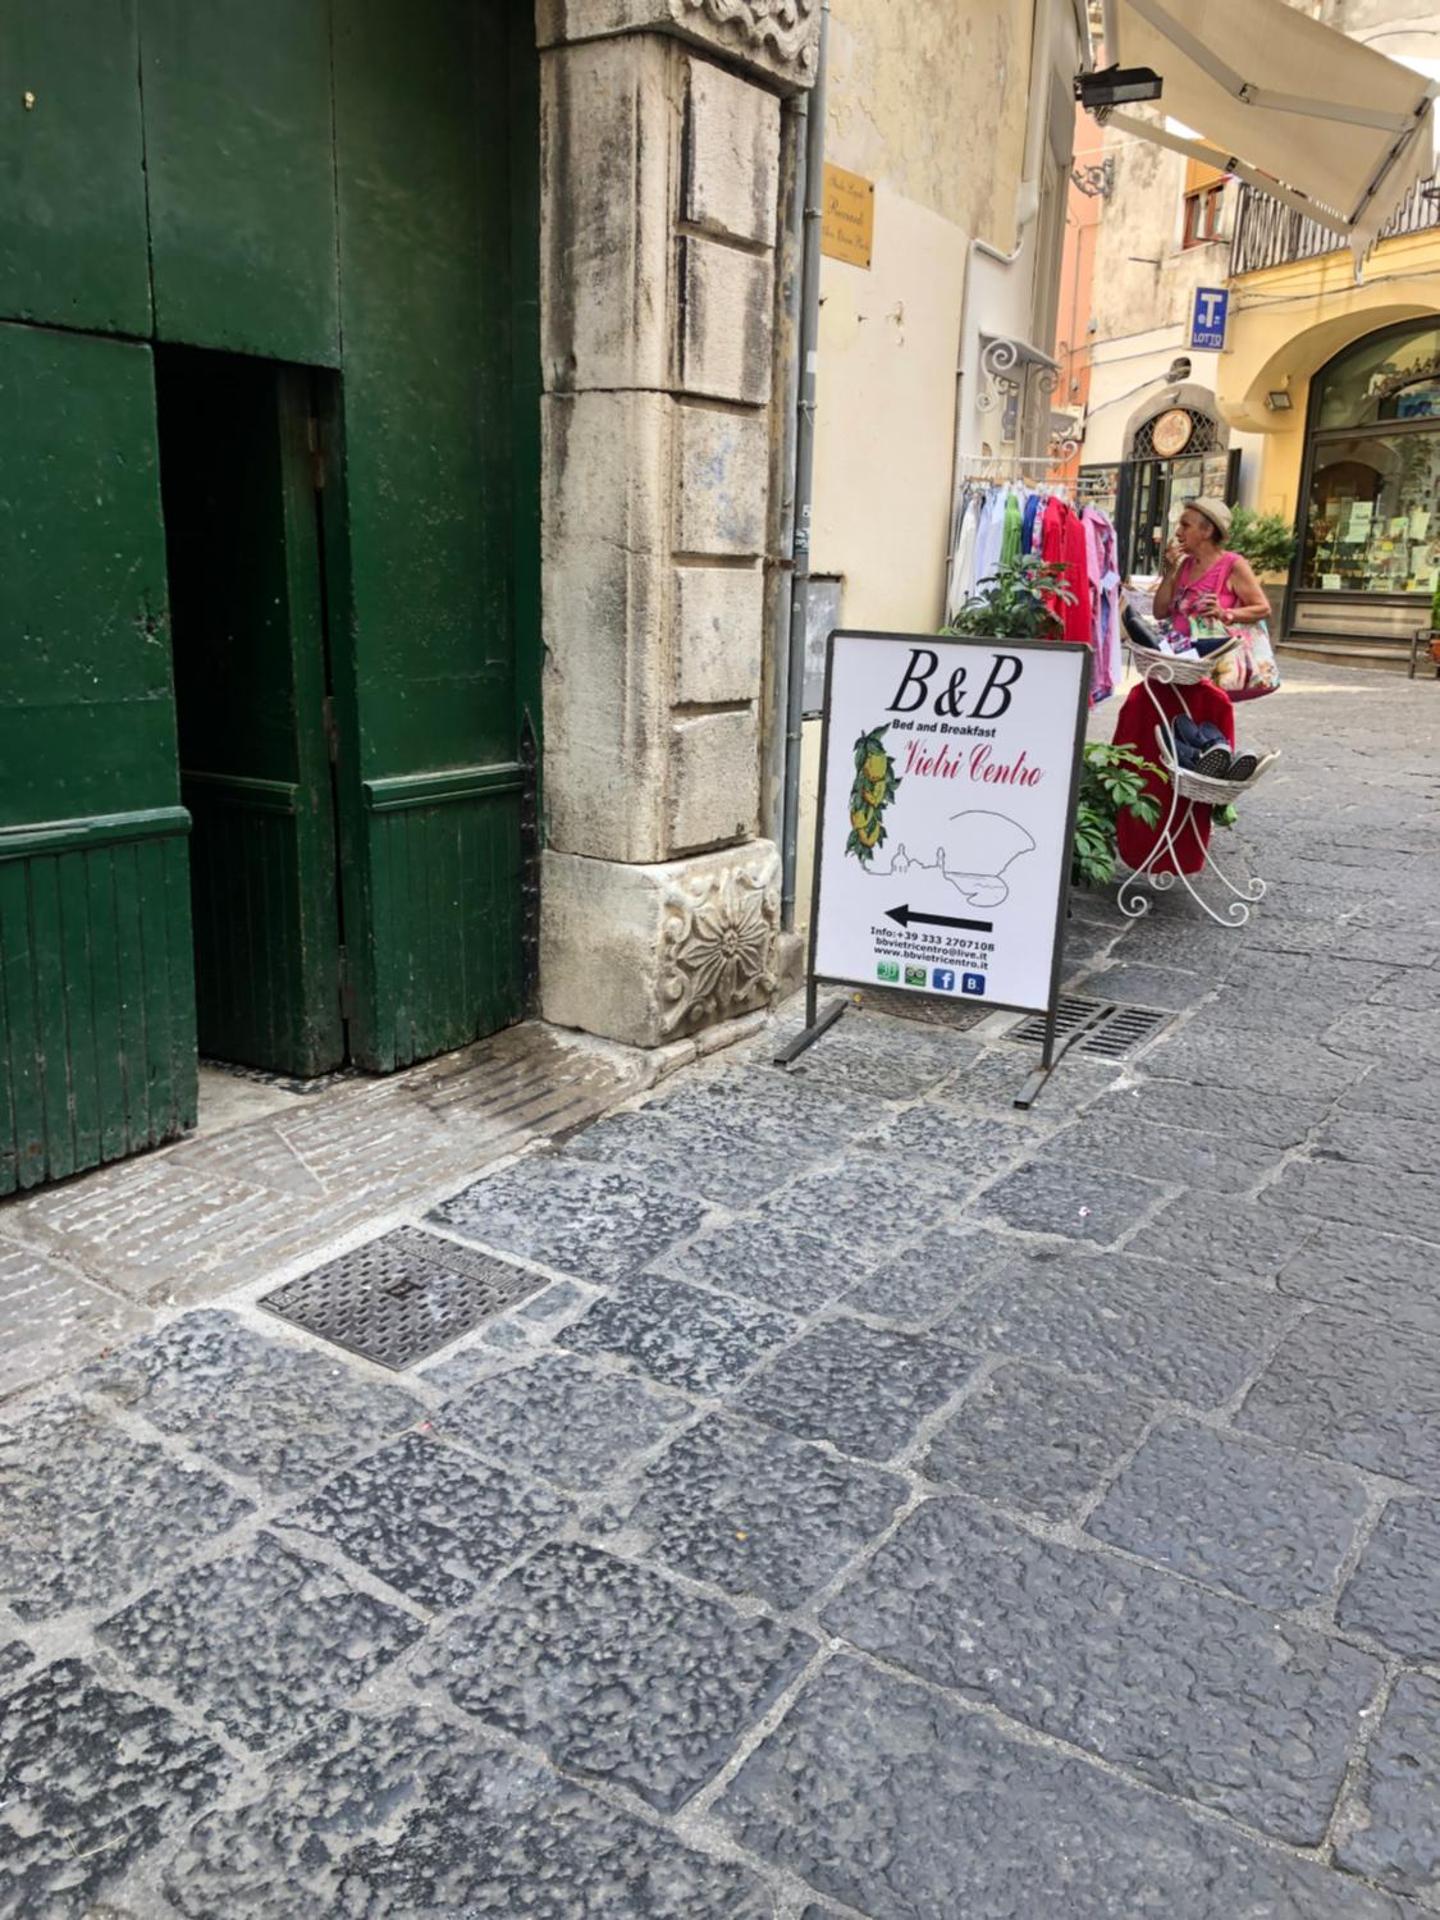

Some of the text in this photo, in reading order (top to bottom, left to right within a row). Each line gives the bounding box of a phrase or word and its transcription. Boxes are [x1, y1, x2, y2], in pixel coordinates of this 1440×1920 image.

[1193, 333, 1222, 347] LOTTO
[892, 718, 997, 739] Bed and Breakfast
[904, 739, 1043, 787] Vietri Centro
[875, 937, 988, 961] bbvietricentro@live.it
[921, 933, 943, 945] 333
[946, 937, 995, 952] 2707108
[873, 946, 989, 970] www.bbvietricentro.it
